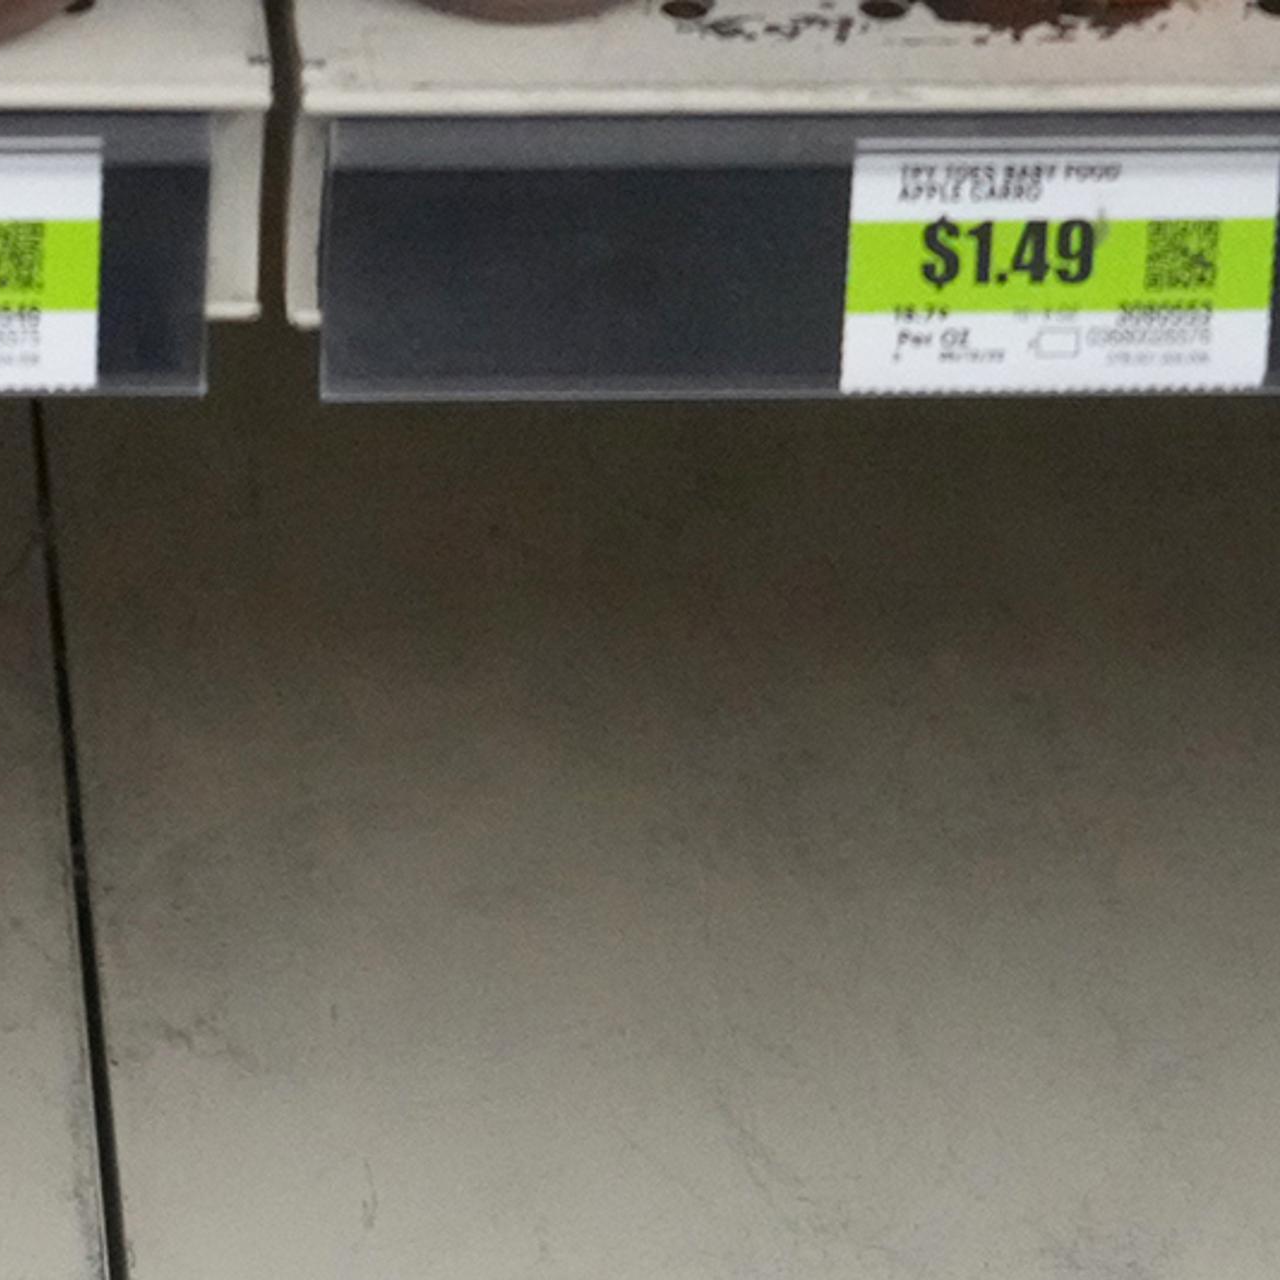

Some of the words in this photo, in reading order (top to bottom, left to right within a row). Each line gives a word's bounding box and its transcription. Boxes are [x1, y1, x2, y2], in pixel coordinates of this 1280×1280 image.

[1003, 163, 1054, 181] BABY
[1065, 162, 1122, 180] FOOD
[899, 183, 961, 201] APPLE
[921, 217, 1094, 291] $1.49
[940, 328, 969, 347] OZ
